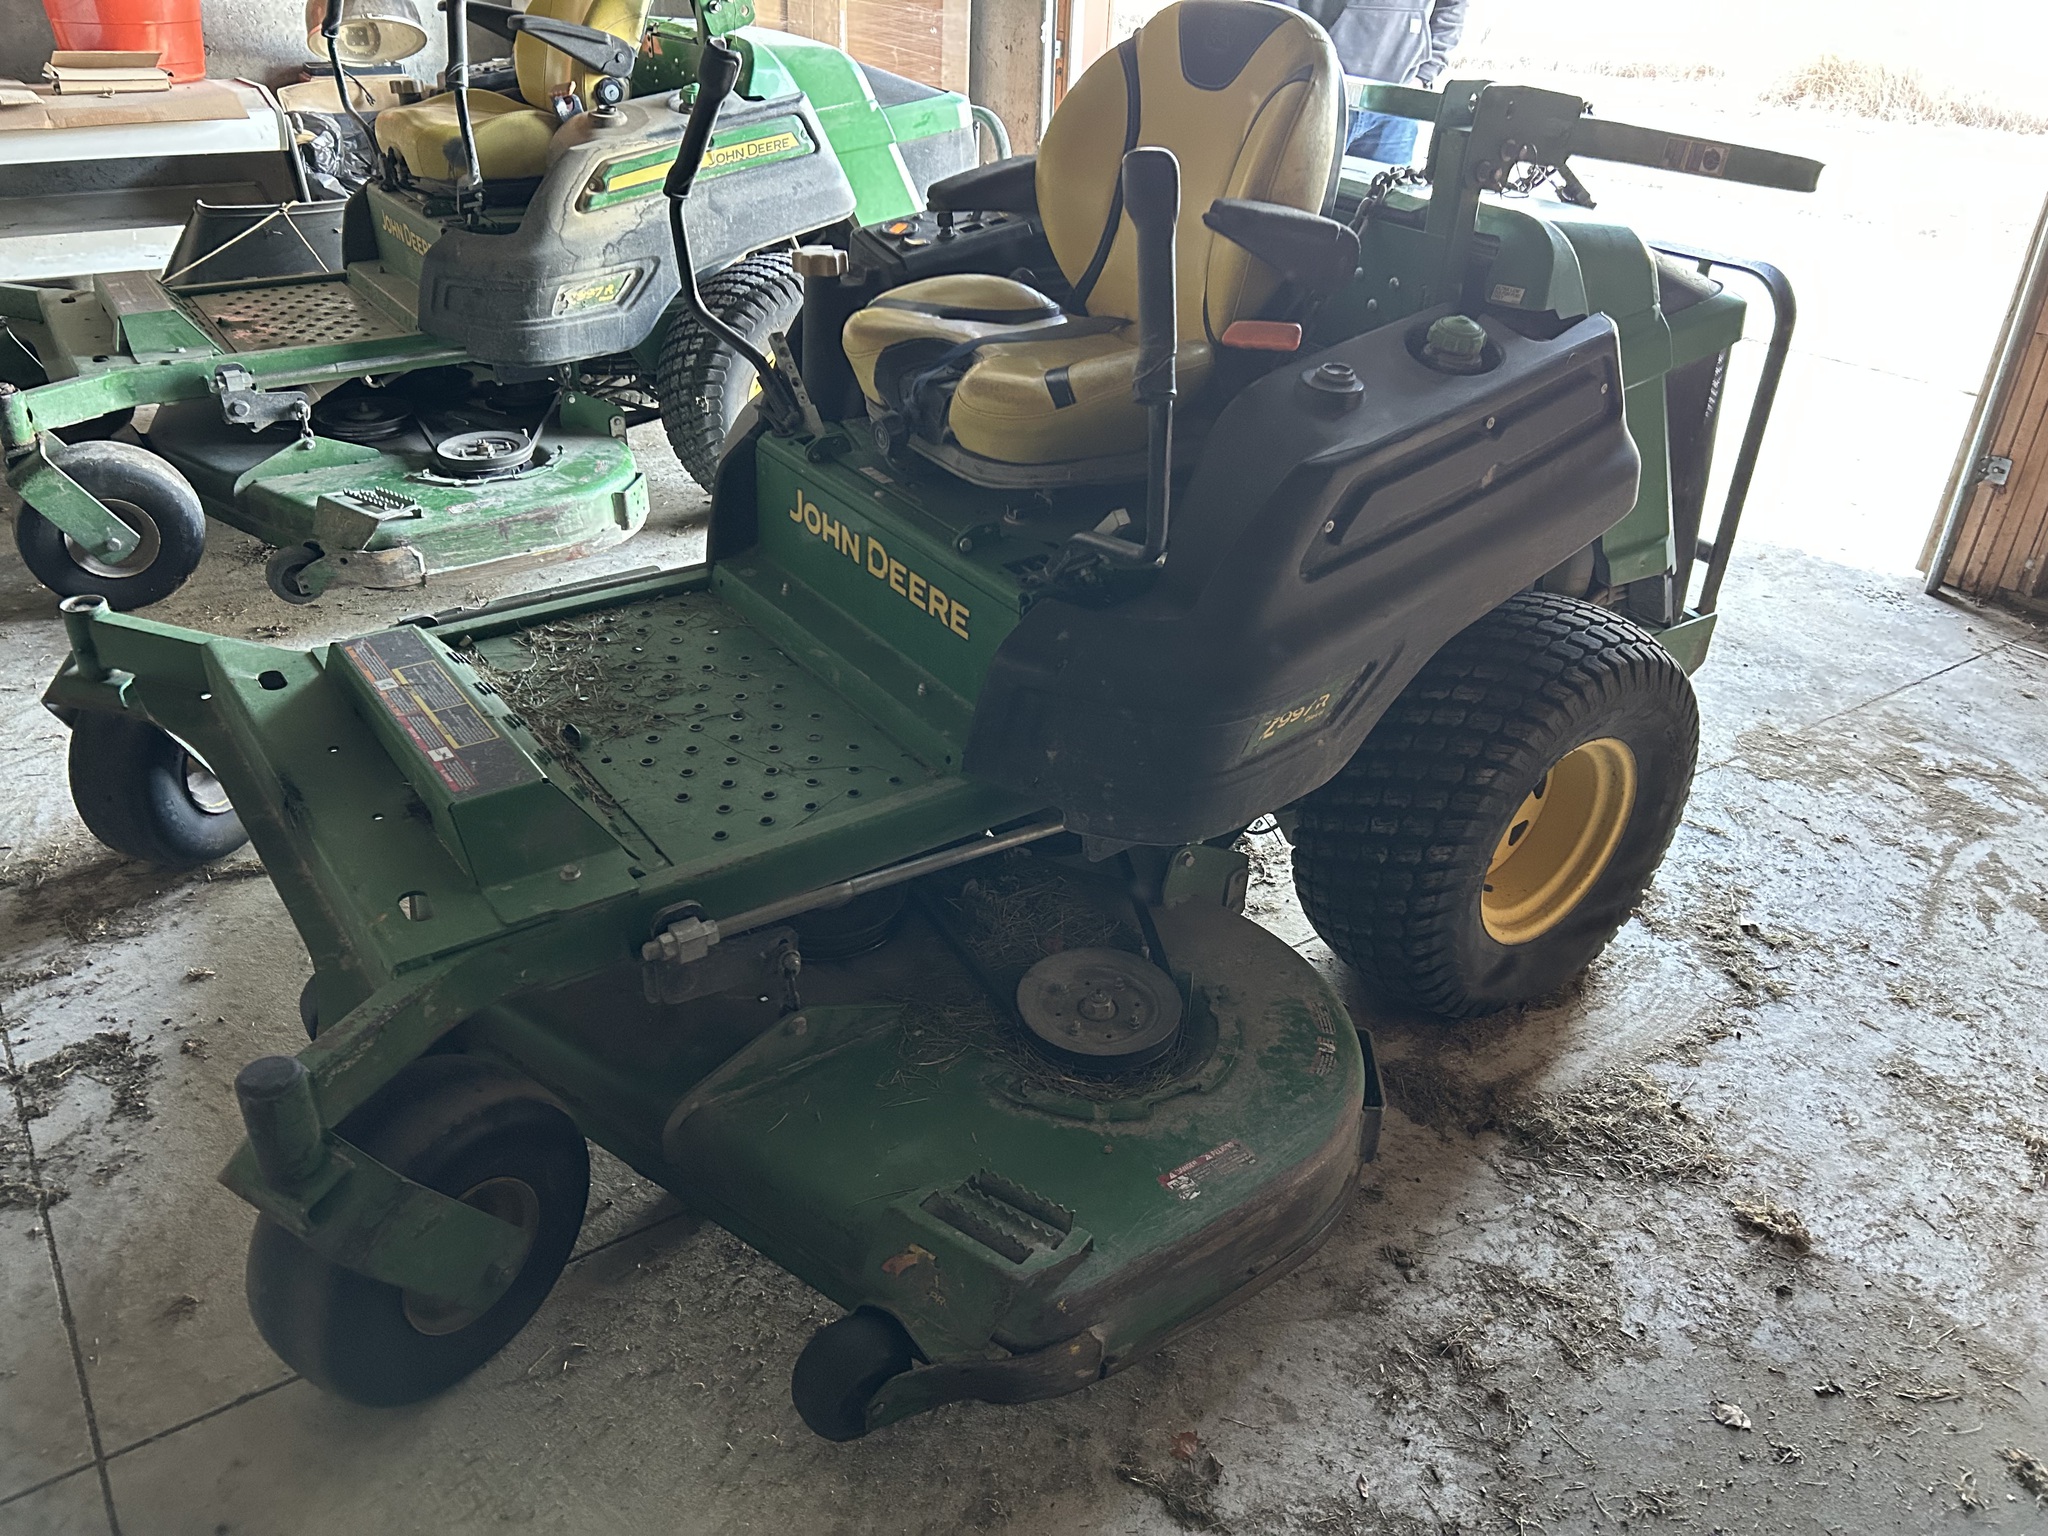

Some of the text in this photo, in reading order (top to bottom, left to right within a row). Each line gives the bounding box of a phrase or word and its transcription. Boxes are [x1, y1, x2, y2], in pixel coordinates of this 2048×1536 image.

[708, 137, 790, 166] JOHN DEERE
[381, 208, 432, 256] JOHN DEER
[789, 488, 970, 641] JOHN DEERE
